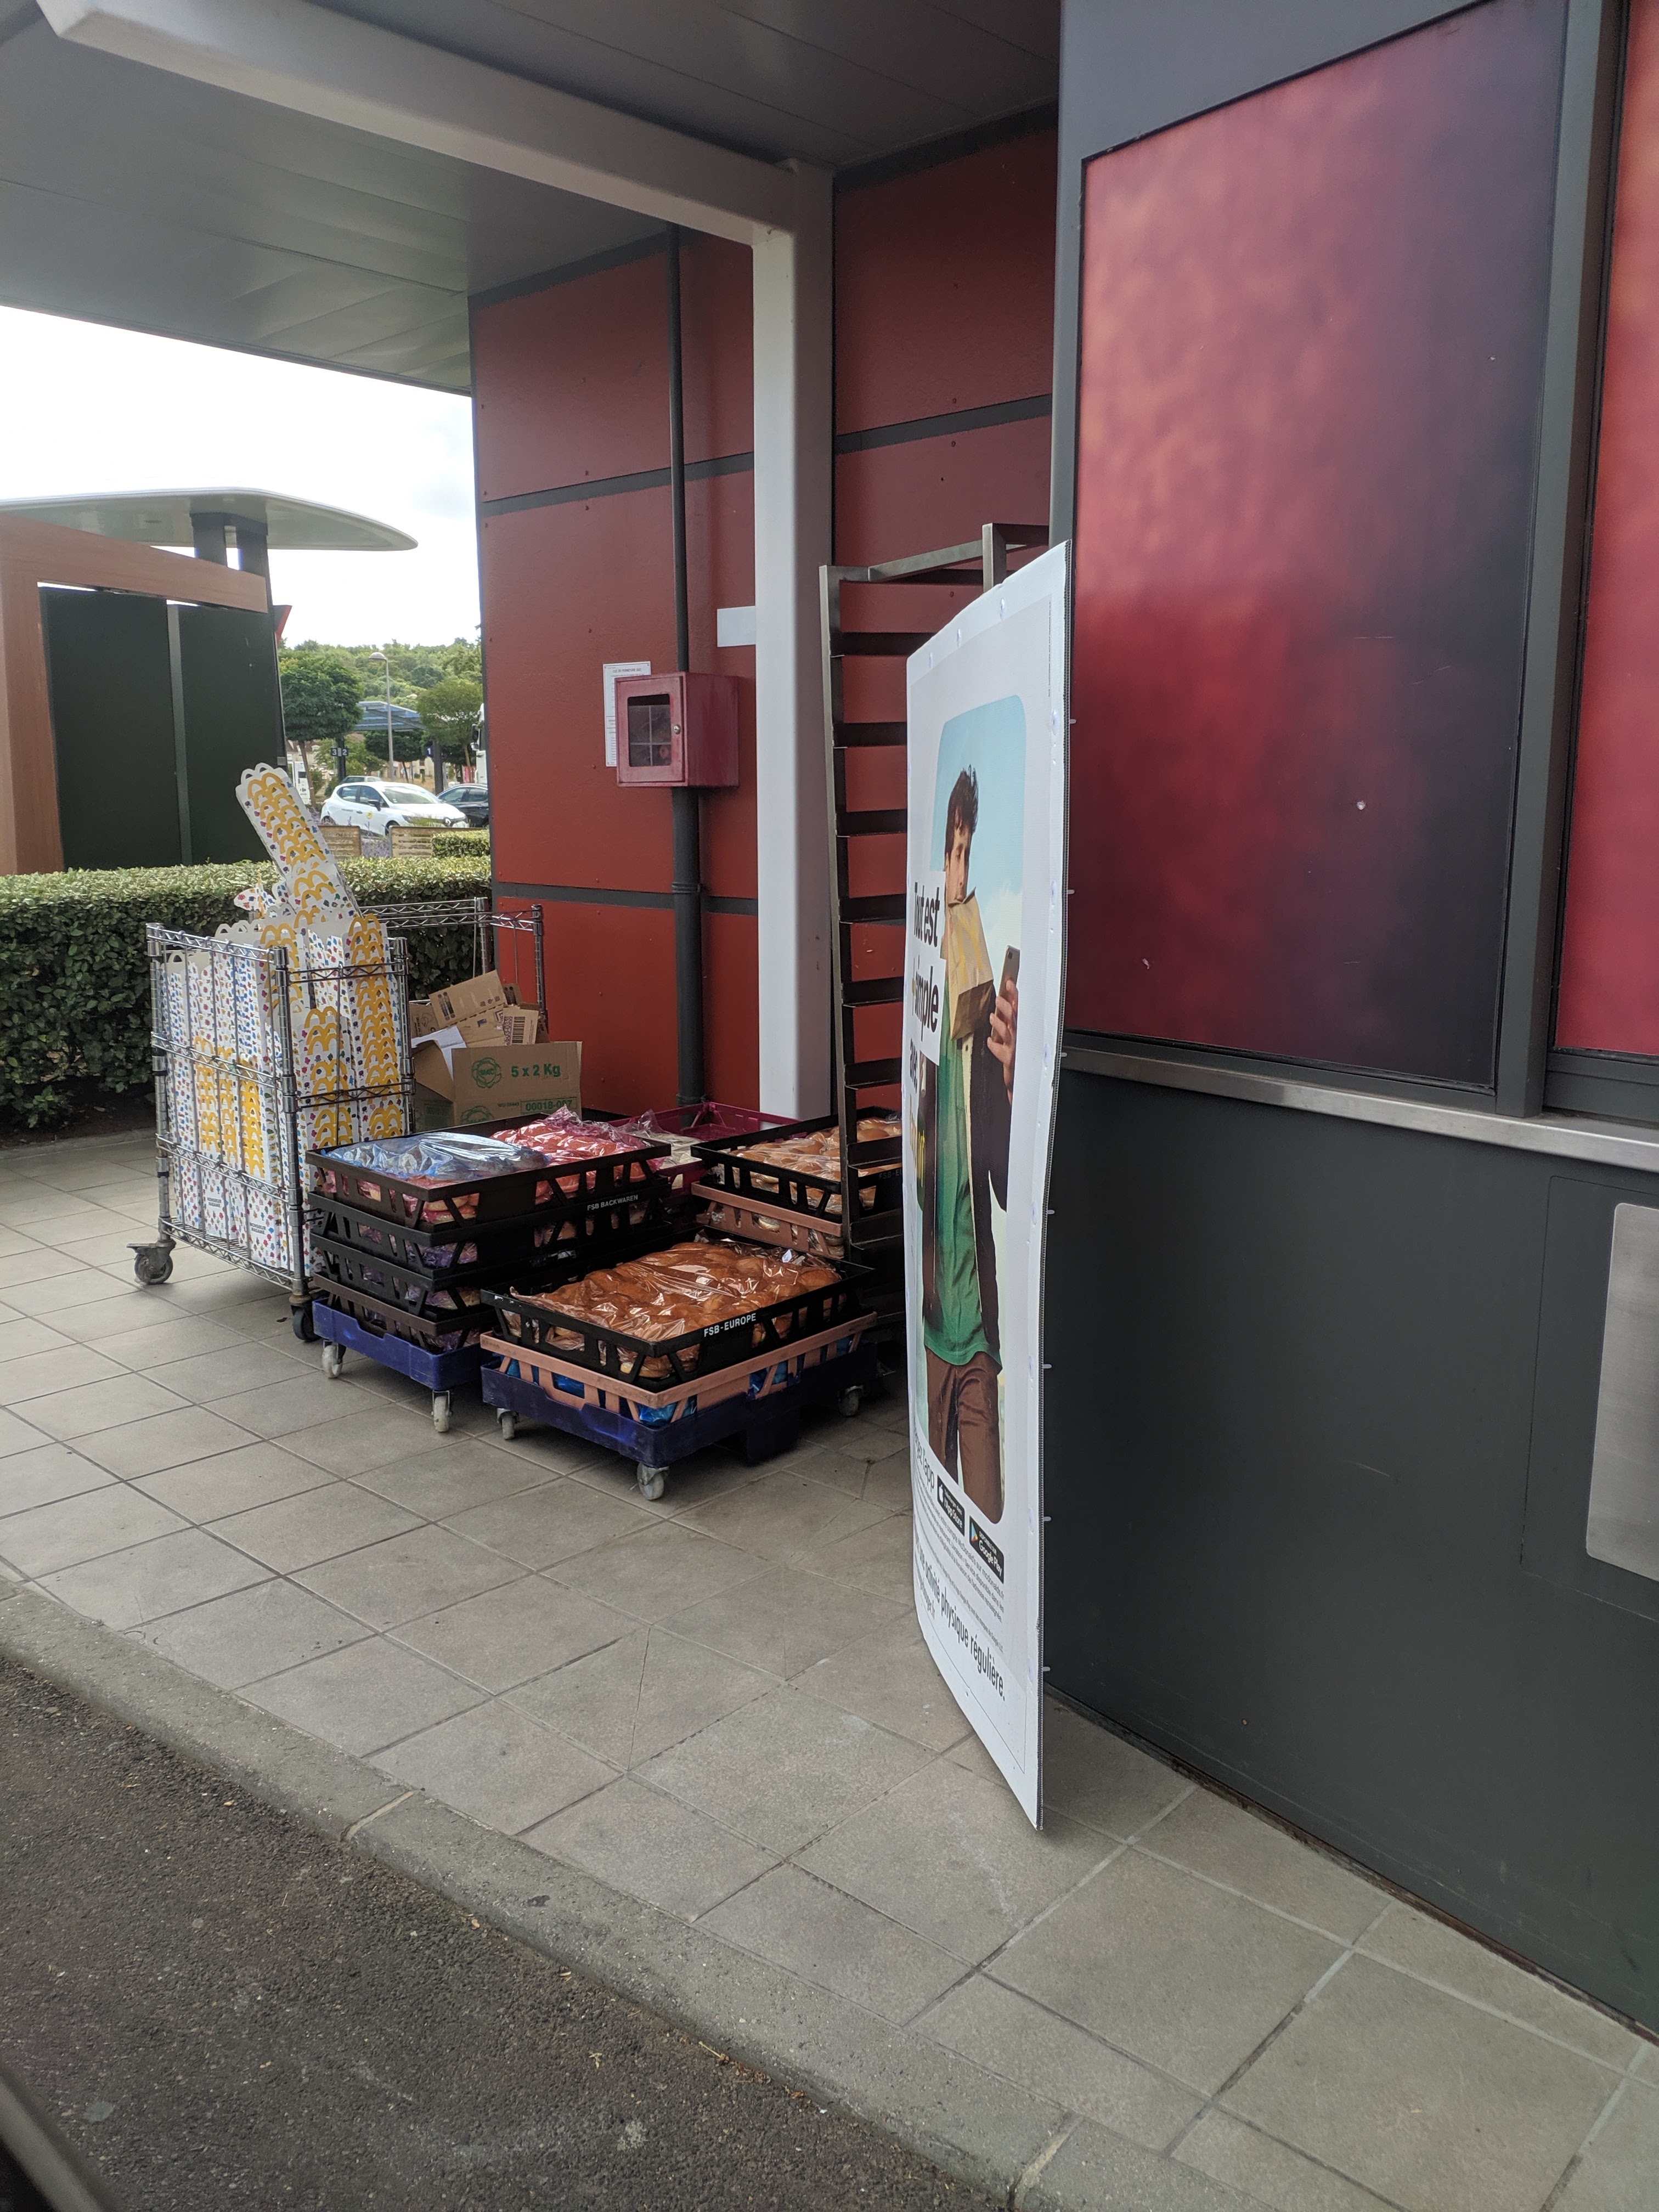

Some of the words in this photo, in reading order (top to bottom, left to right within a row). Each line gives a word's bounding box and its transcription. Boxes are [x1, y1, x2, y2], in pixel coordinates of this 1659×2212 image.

[914, 882, 924, 941] Tout
[924, 887, 940, 947] est
[915, 954, 939, 1042] simple
[511, 1066, 518, 1077] 5
[522, 1068, 529, 1077] x
[533, 1064, 540, 1076] 2
[544, 1063, 561, 1077] Kg
[601, 1195, 638, 1208] BACKWAREN
[704, 1313, 756, 1337] FSB-EUROPE
[923, 1447, 934, 1492] l'app
[952, 1509, 963, 1528] Store
[958, 1536, 975, 1566] McDonald's
[982, 1566, 1004, 1602] mcdonalds.fr
[965, 1558, 975, 1578] Service
[976, 1571, 990, 1598] disponible
[979, 1540, 994, 1564] Google
[994, 1554, 1002, 1577] Play
[926, 1561, 940, 1603] activité
[941, 1587, 969, 1647] physique
[970, 1634, 1006, 1702] régulière.
